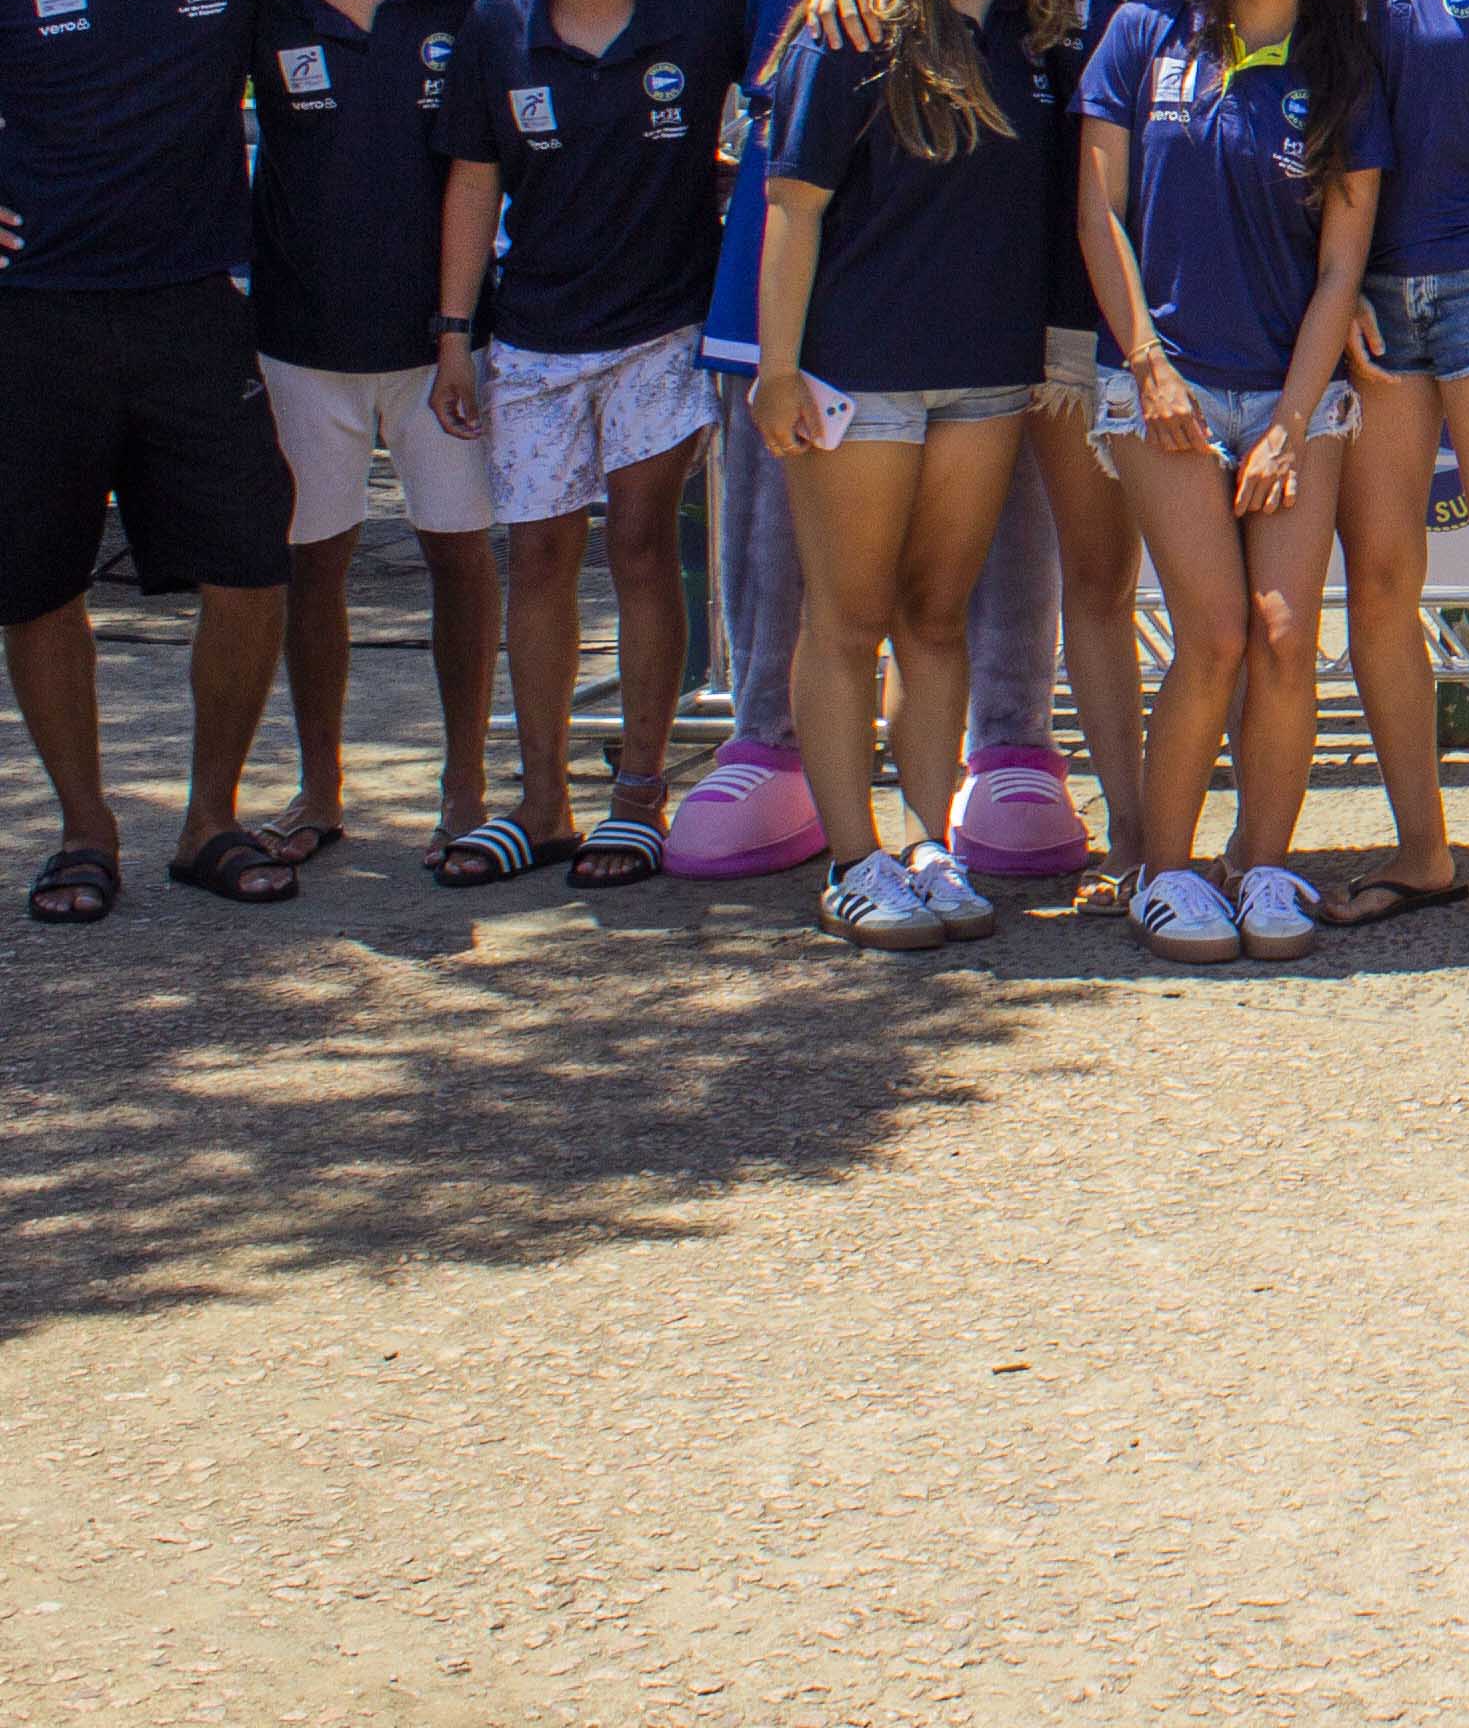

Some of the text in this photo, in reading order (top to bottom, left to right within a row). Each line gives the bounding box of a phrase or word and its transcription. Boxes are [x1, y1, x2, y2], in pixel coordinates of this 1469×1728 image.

[38, 22, 75, 37] vero
[292, 99, 323, 111] vero
[1435, 499, 1469, 523] SU
